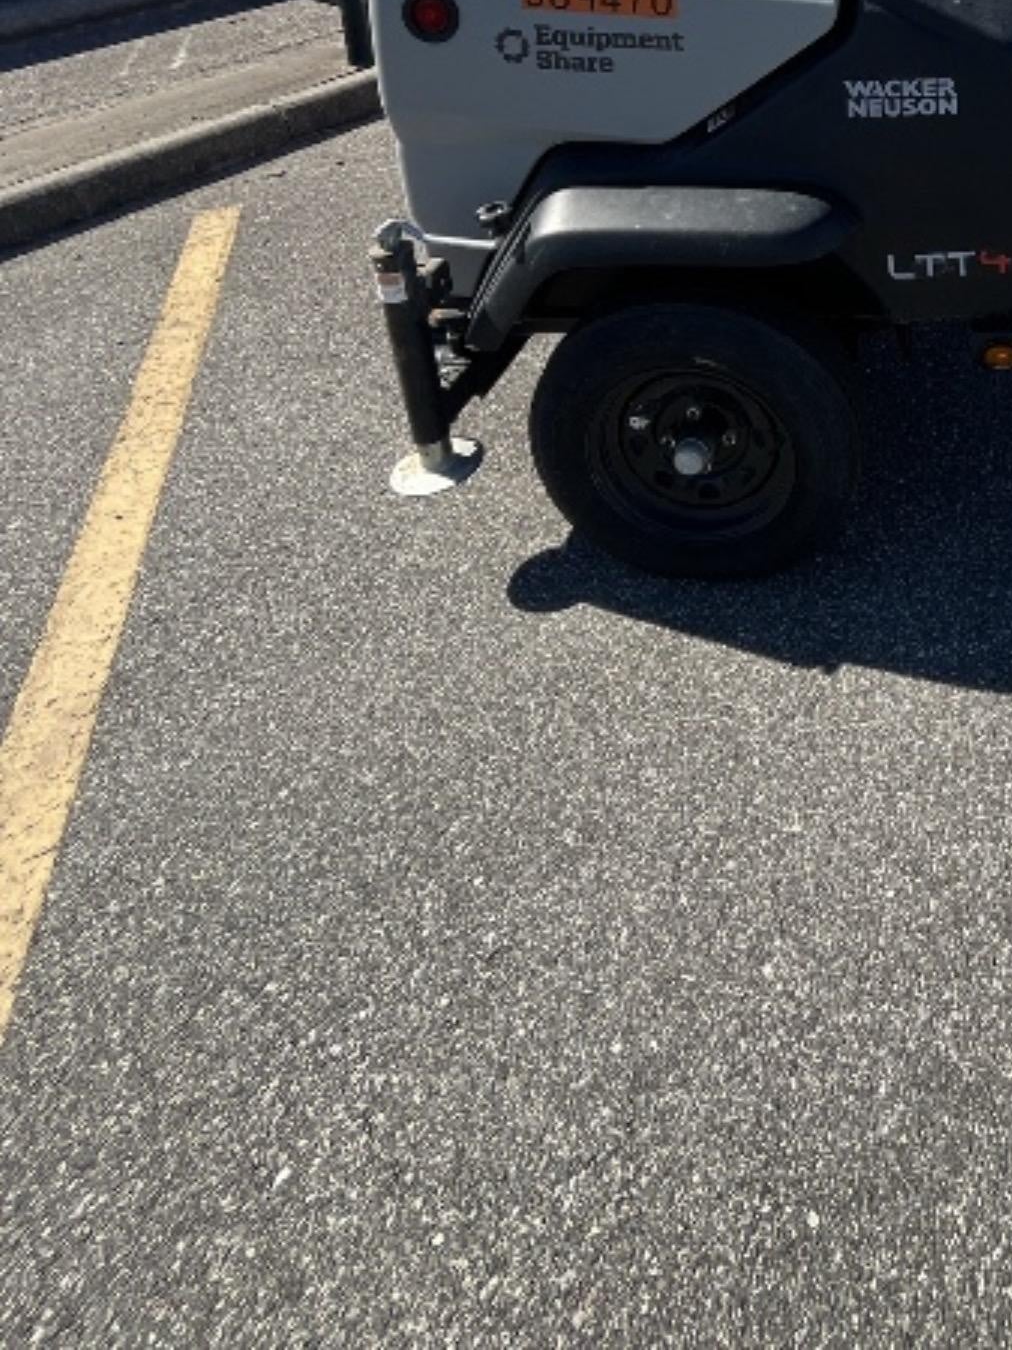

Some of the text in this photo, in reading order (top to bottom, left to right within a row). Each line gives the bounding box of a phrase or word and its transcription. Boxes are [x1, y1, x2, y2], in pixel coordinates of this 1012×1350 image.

[534, 24, 686, 51] Equipment
[536, 51, 614, 73] Share
[843, 77, 957, 98] WACKER
[848, 98, 958, 118] NEUSON
